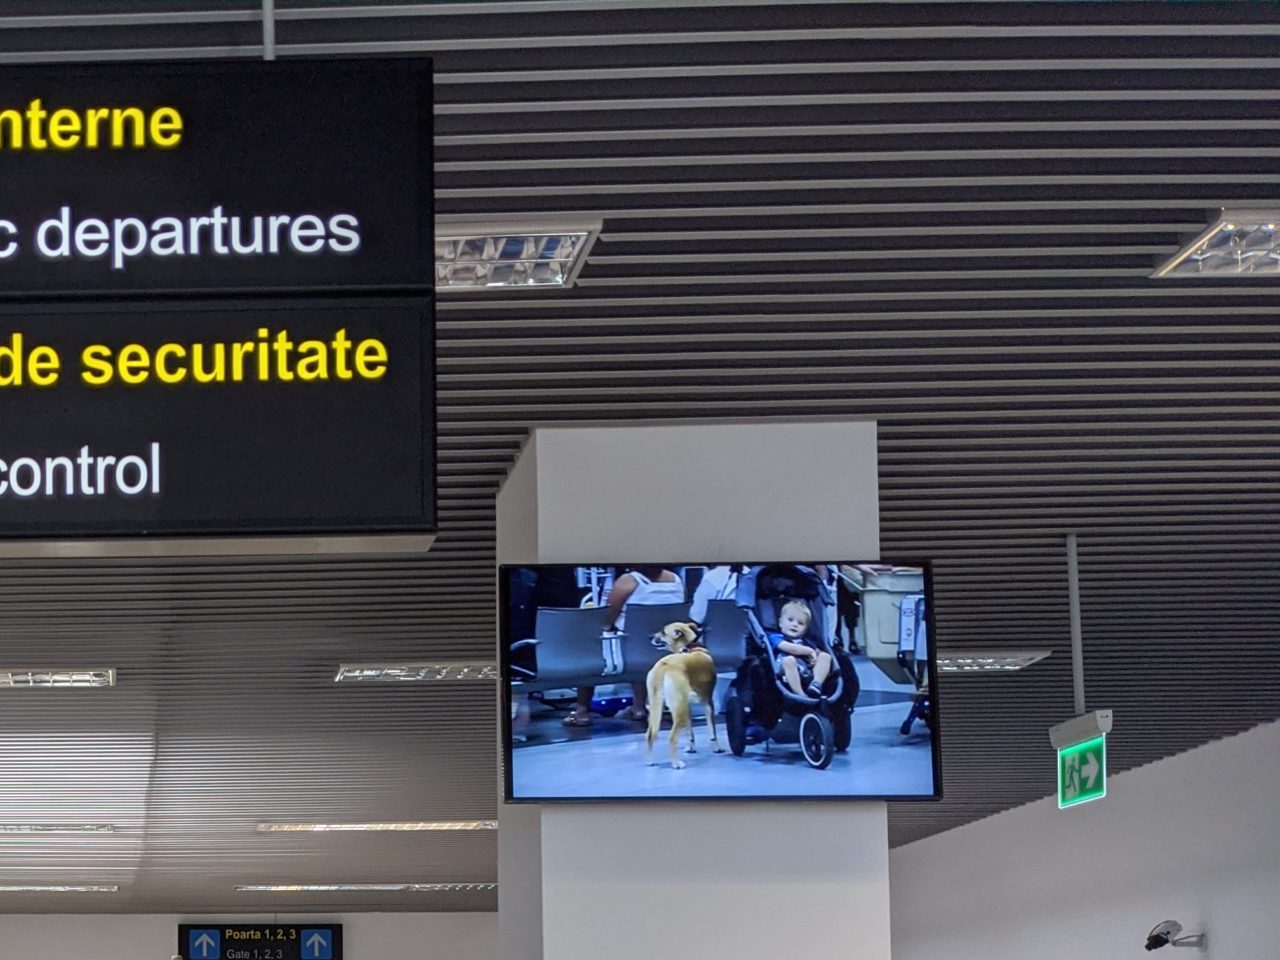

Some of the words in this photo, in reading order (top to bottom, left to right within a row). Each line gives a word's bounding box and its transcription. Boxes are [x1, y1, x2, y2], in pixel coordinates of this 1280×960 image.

[35, 204, 361, 270] departures
[80, 326, 389, 386] securitate
[225, 928, 261, 940] Poarta
[264, 928, 274, 940] 1,
[276, 928, 287, 941] 2,
[289, 928, 297, 940] 3
[226, 949, 250, 959] Gate
[276, 949, 283, 959] 3
